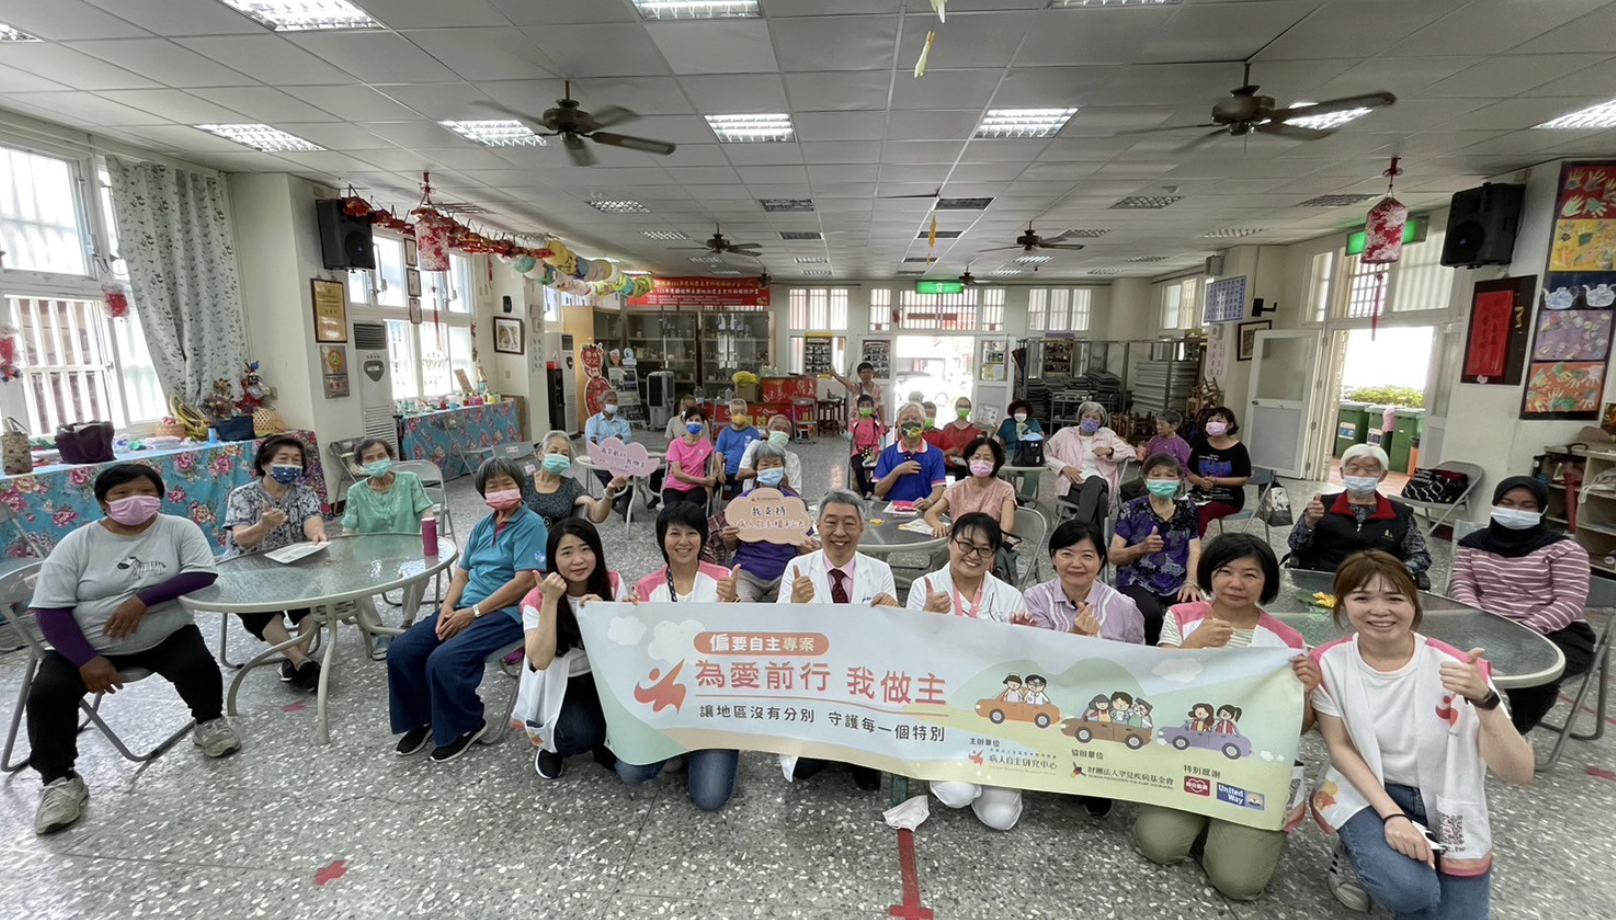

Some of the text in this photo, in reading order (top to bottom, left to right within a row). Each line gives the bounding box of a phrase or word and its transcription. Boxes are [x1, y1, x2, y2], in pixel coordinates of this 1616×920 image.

[752, 506, 786, 516] 我支持
[709, 633, 815, 652] 偏要自主專案
[695, 659, 947, 705] 為愛前行 我做主
[700, 705, 945, 742] 讓地區沒有分別 守護每一個特別
[989, 754, 1058, 770] 病人自主研究中心
[1218, 784, 1244, 798] United
[1227, 794, 1244, 805] Way
